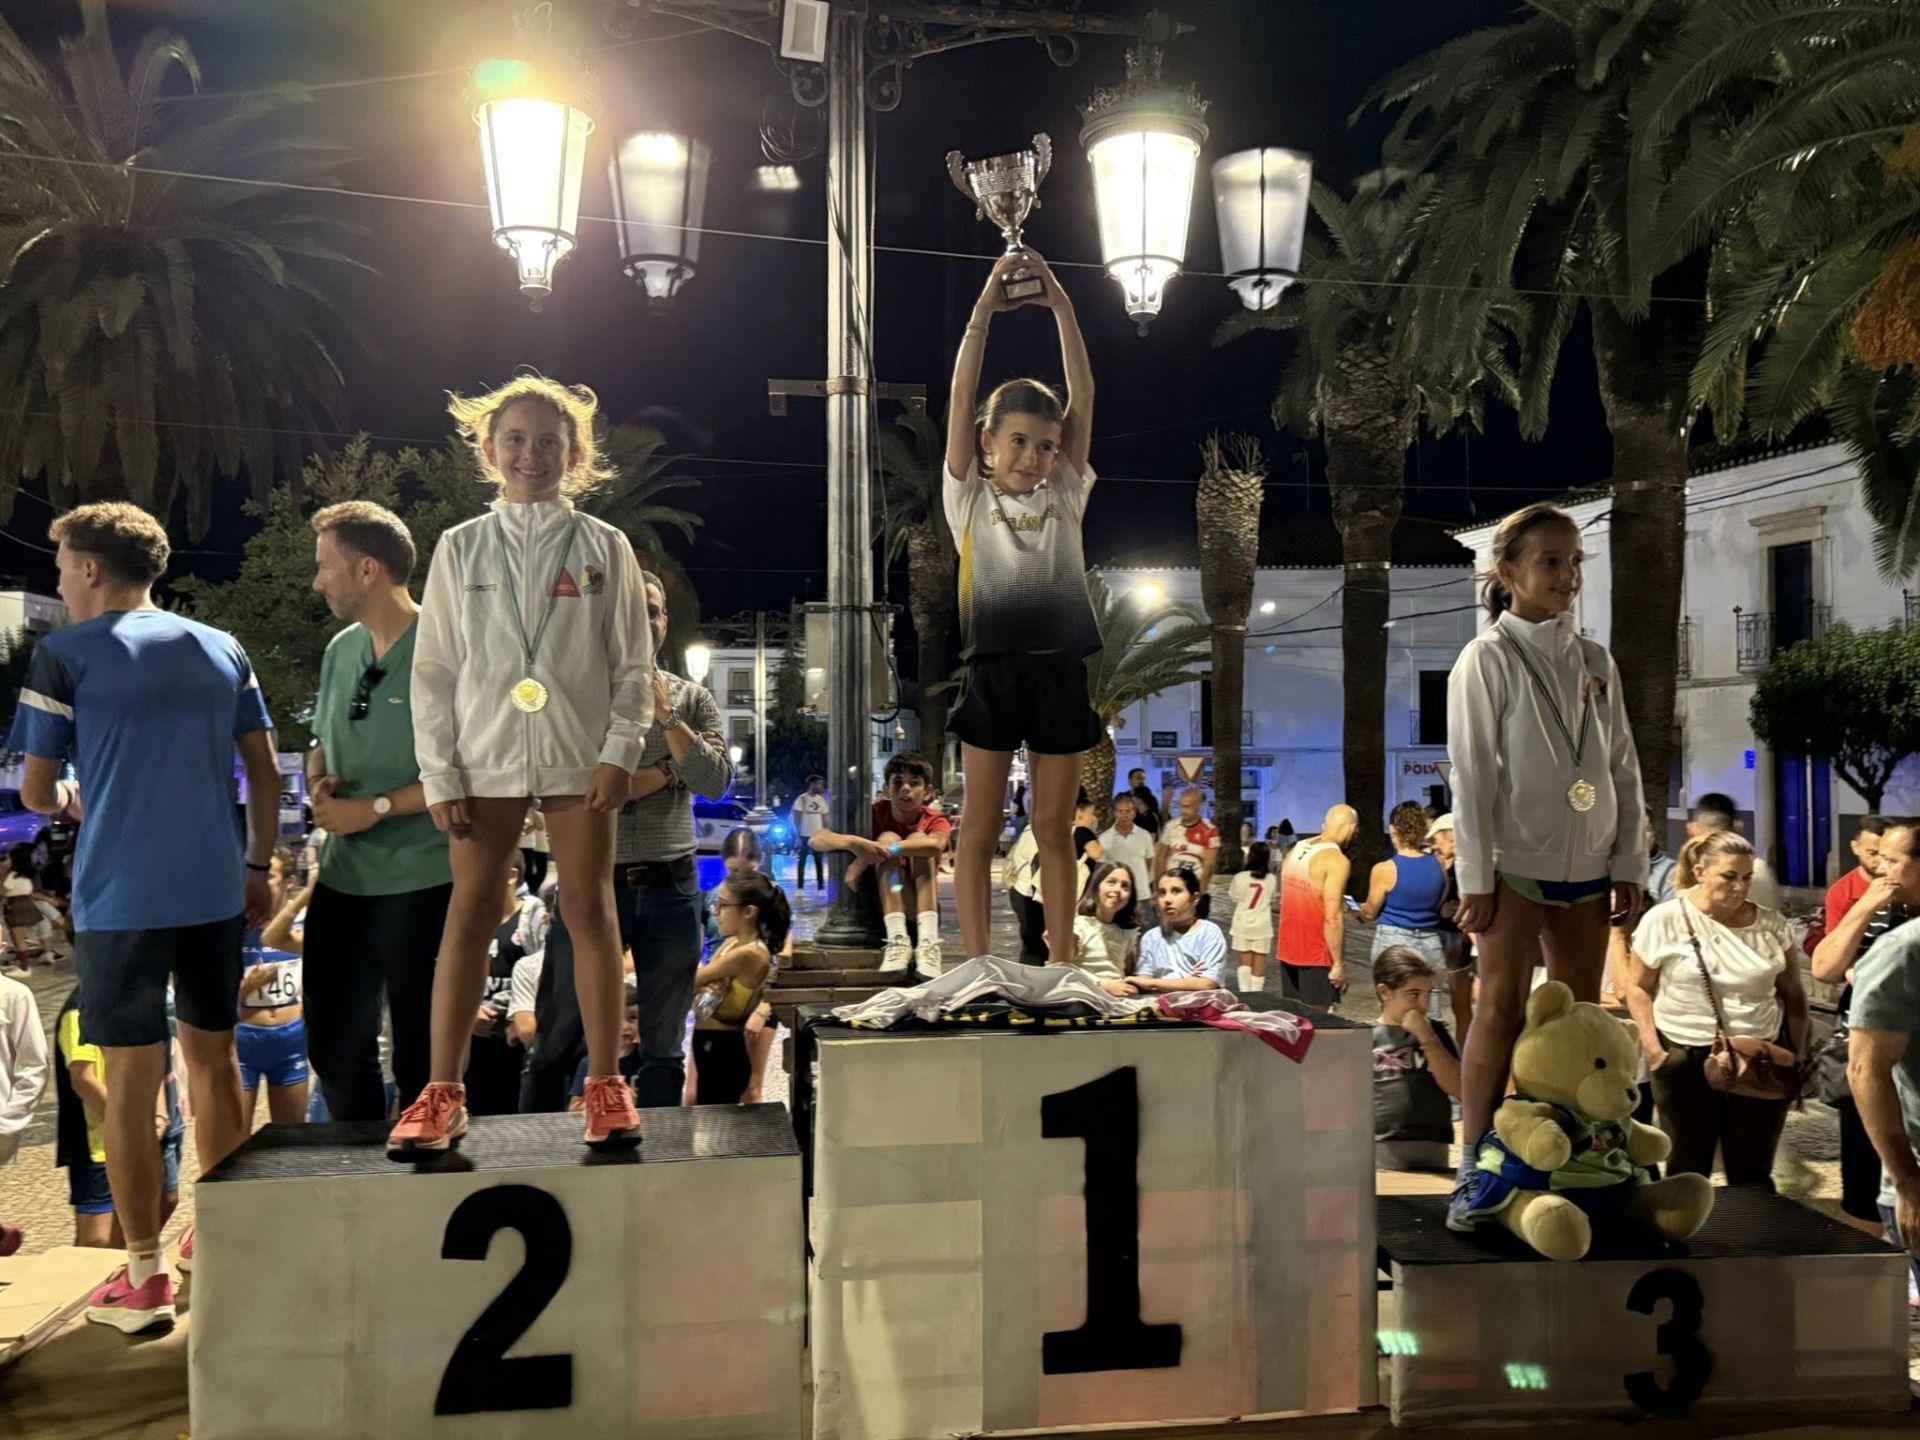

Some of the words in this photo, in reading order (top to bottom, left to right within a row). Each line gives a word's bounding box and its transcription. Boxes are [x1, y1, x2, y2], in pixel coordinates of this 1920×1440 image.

[1248, 883, 1264, 909] 7
[434, 1184, 572, 1415] 2
[1041, 1066, 1182, 1375] 1
[1624, 1267, 1713, 1418] 3
